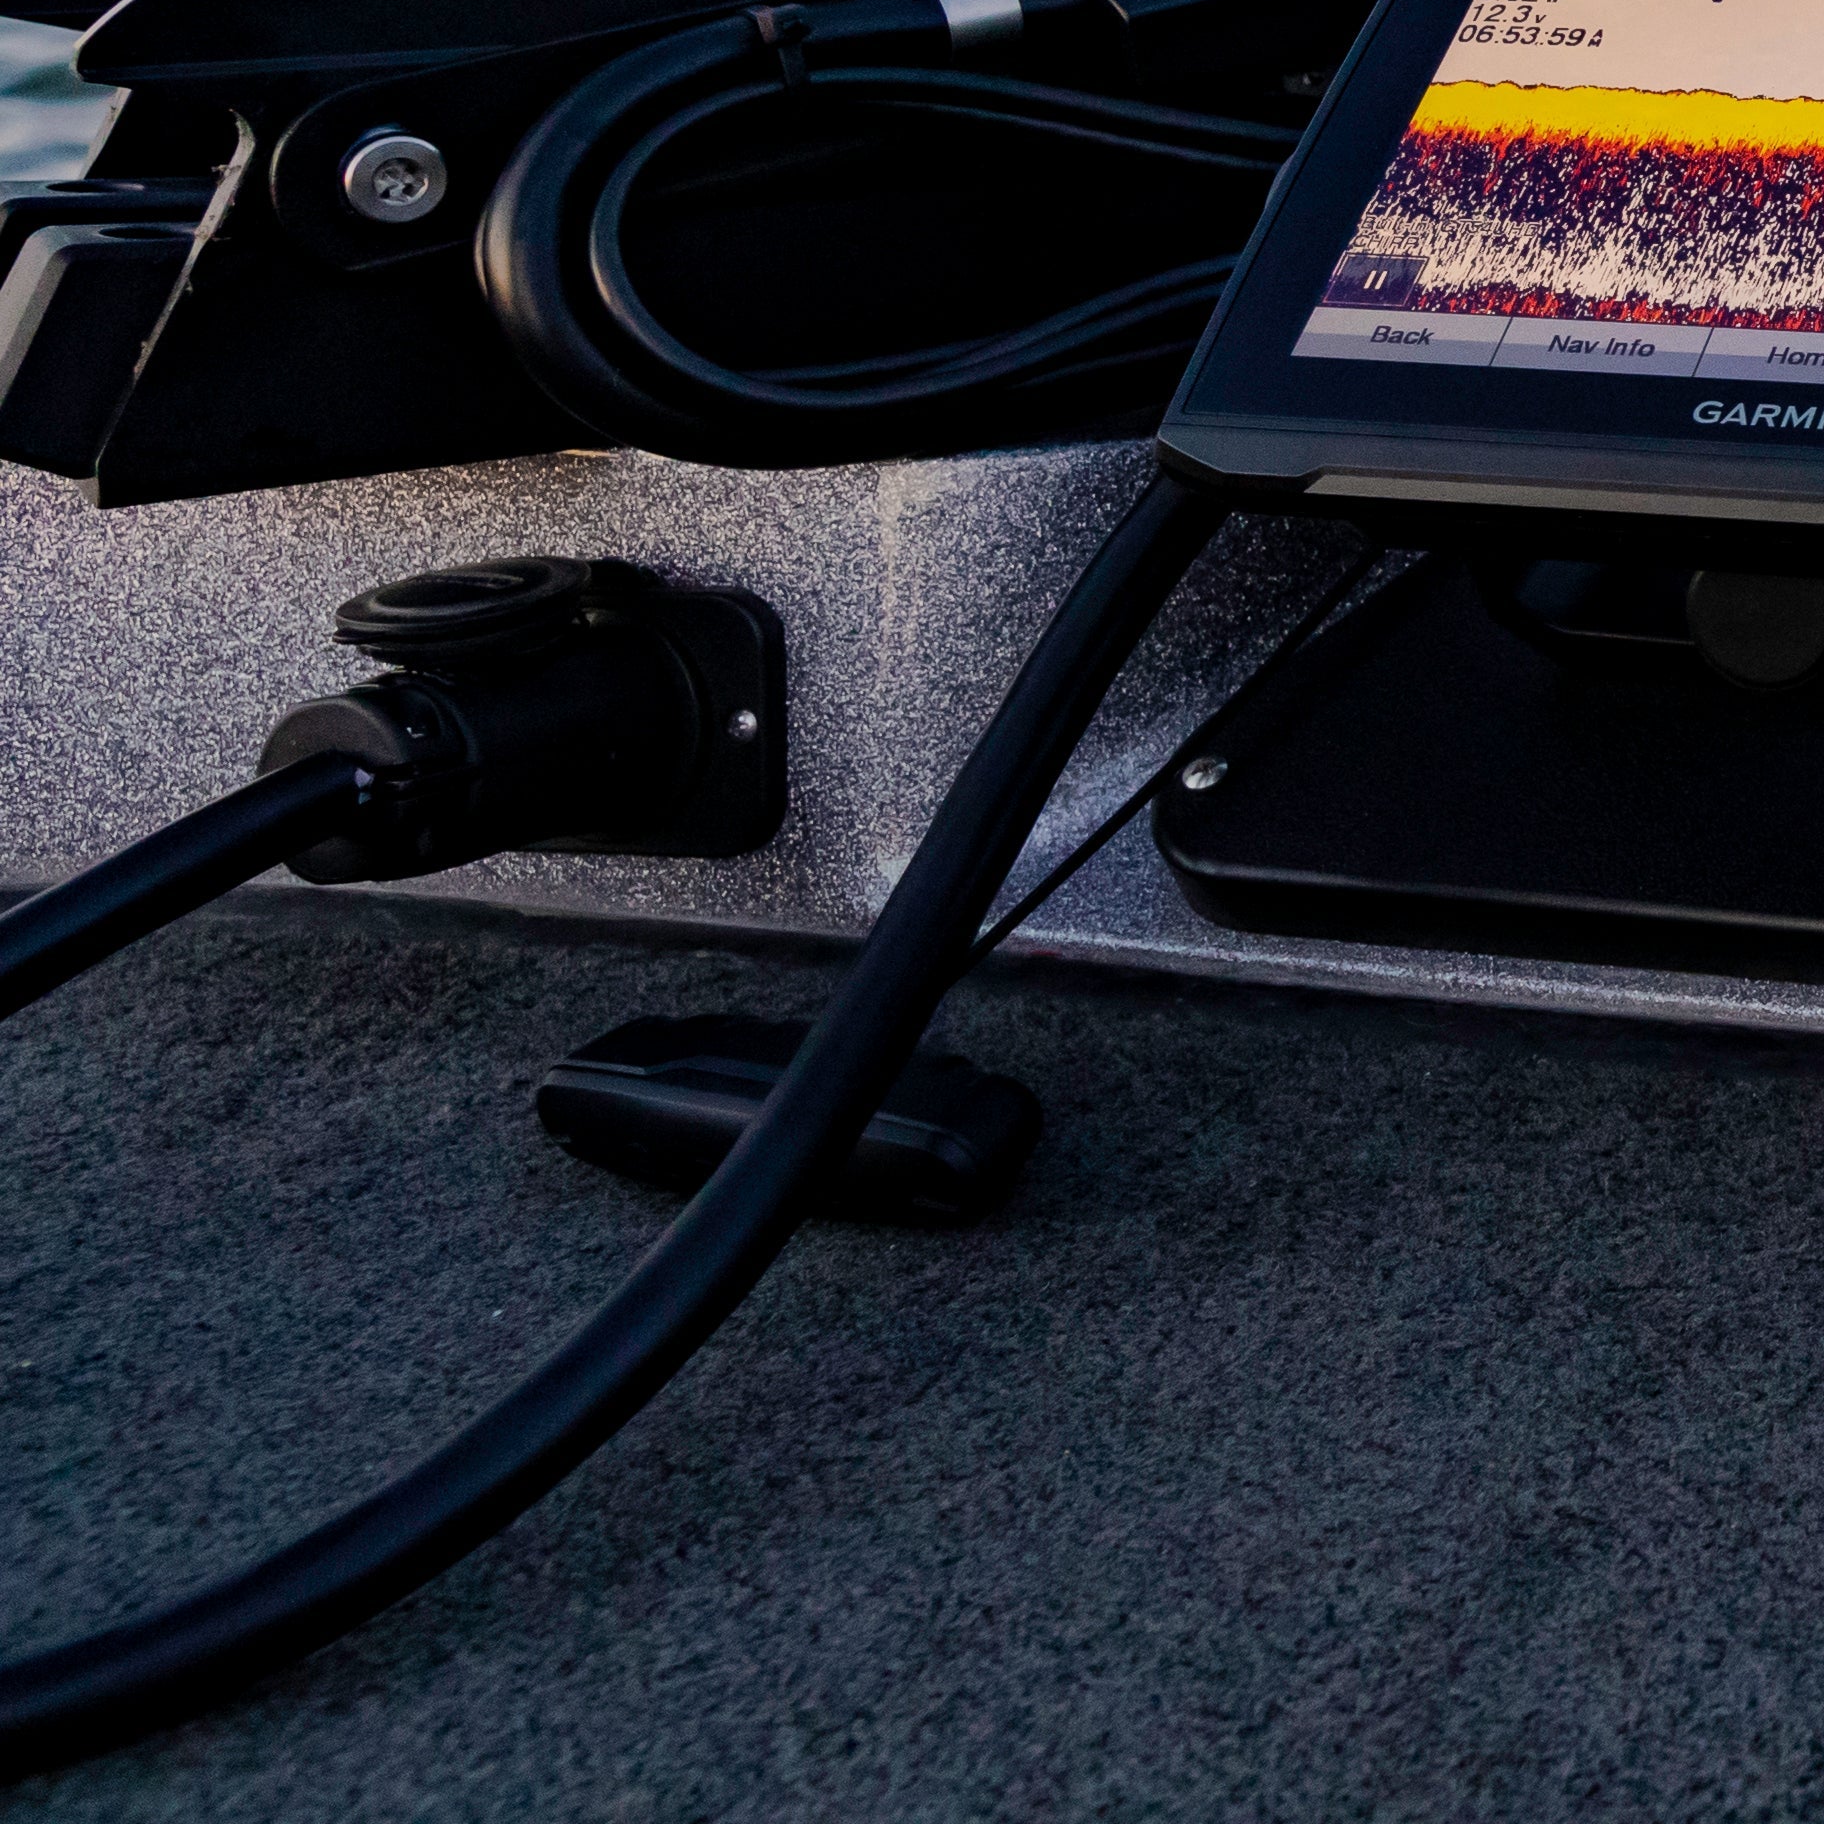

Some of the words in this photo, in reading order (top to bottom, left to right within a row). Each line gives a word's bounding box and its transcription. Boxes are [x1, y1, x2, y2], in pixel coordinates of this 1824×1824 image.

[1472, 4, 1533, 23] 12.3
[1371, 325, 1434, 345] Back
[1548, 335, 1600, 354] Nav
[1604, 338, 1656, 357] Info
